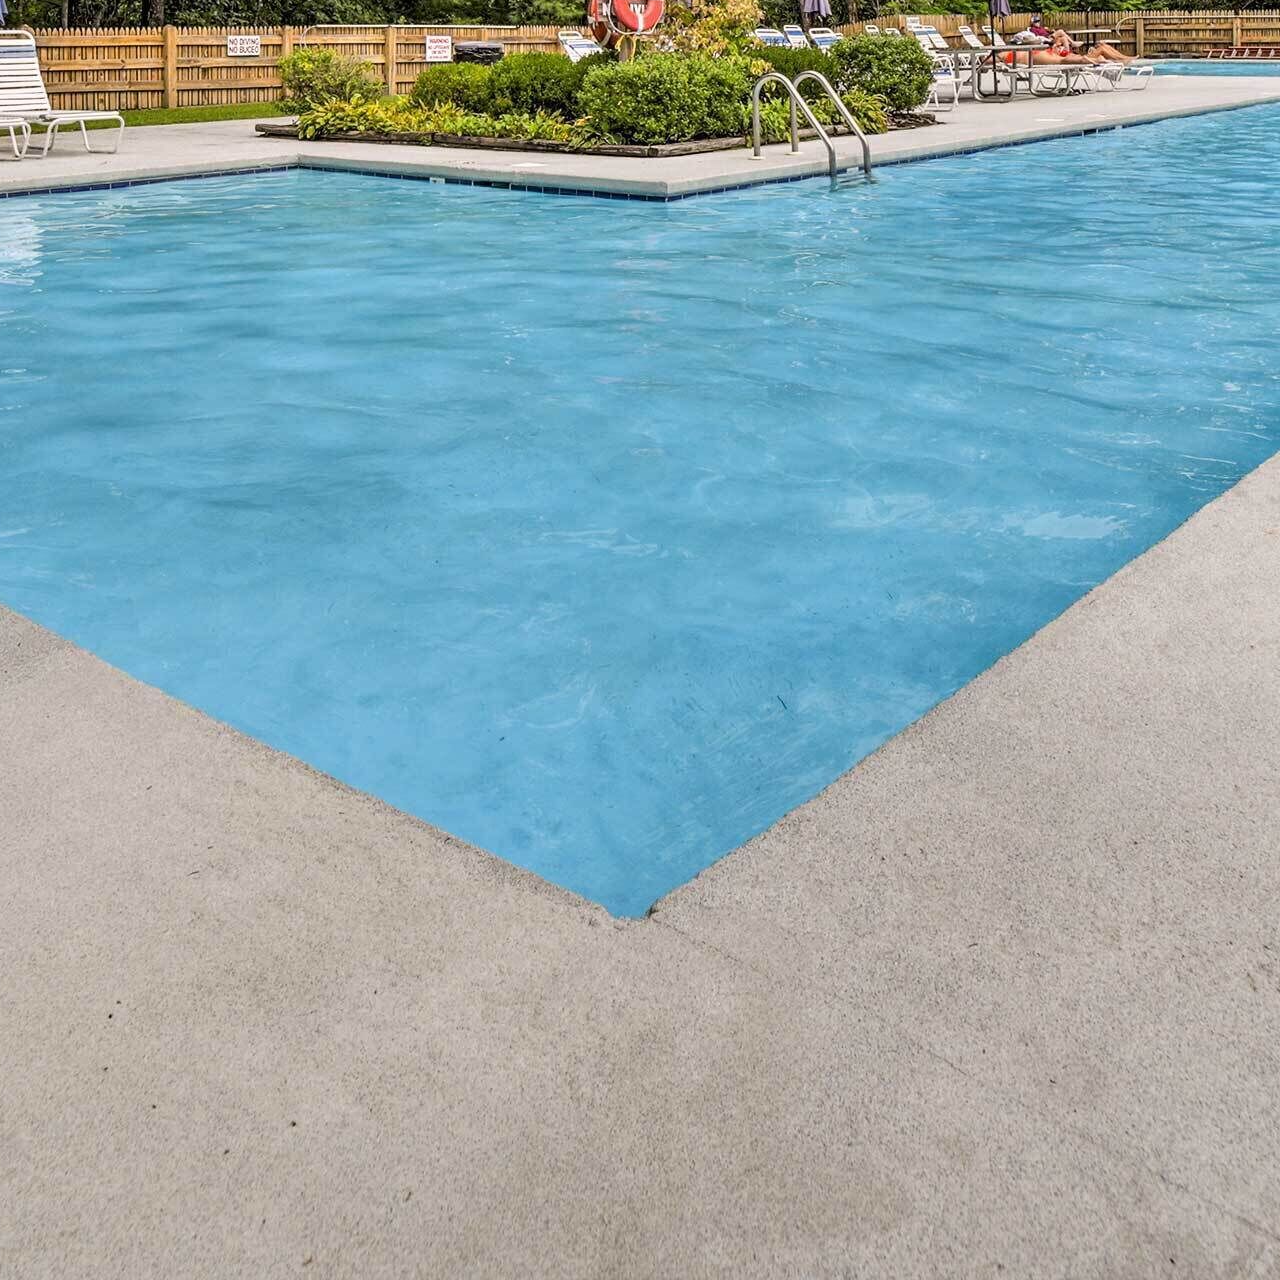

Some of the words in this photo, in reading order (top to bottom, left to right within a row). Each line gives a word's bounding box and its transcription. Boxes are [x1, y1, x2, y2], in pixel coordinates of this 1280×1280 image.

[229, 38, 238, 46] NO
[239, 38, 259, 46] DIVING
[229, 46, 238, 54] NO
[239, 46, 259, 54] BUCEO
